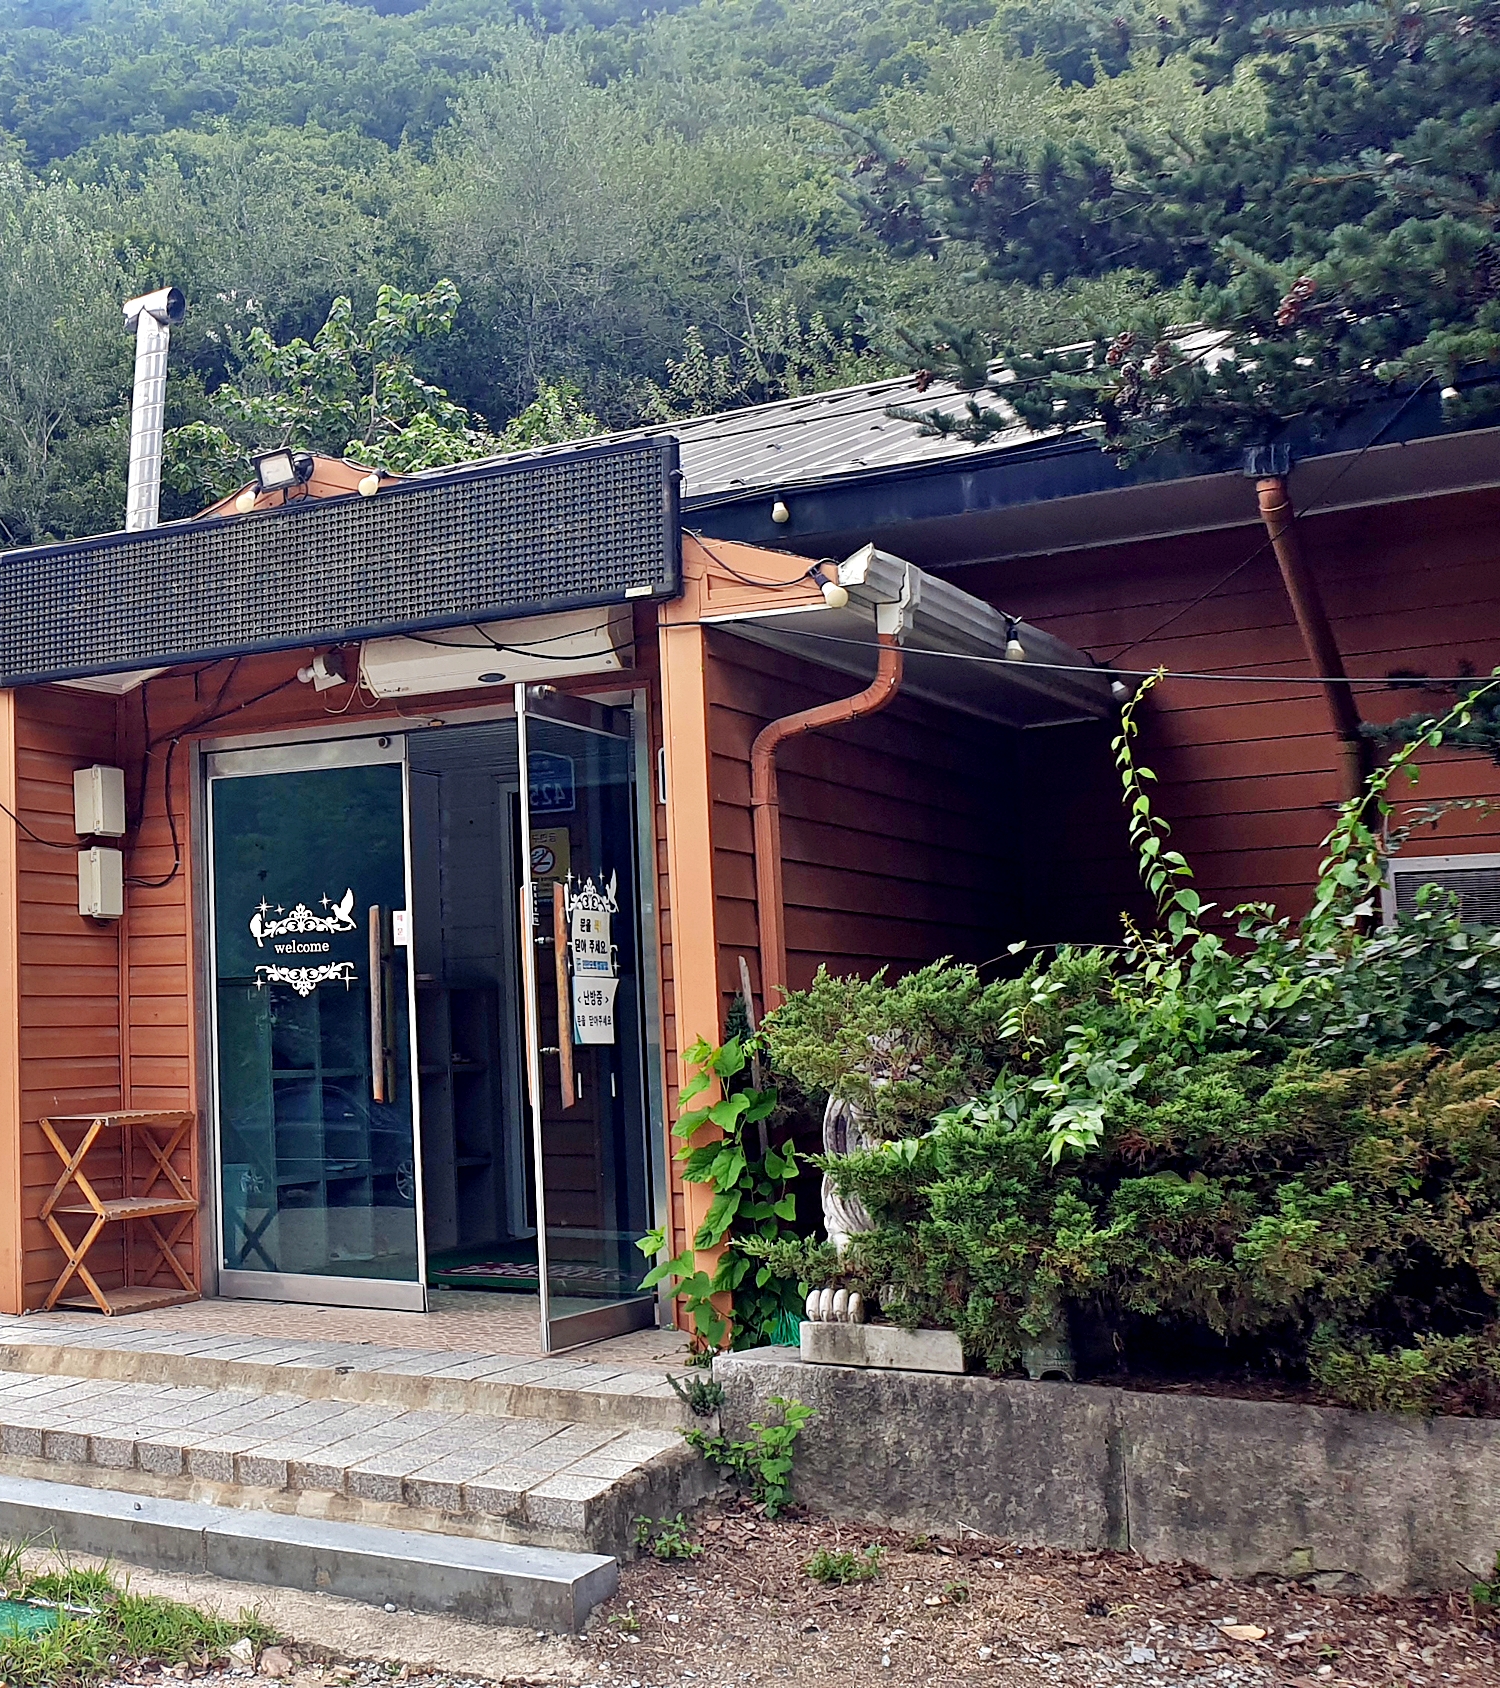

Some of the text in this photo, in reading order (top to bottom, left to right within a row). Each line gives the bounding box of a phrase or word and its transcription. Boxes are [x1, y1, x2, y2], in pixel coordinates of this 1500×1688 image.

[580, 918, 592, 933] 문을
[274, 939, 330, 954] welcome
[583, 990, 603, 1006] 난방중
